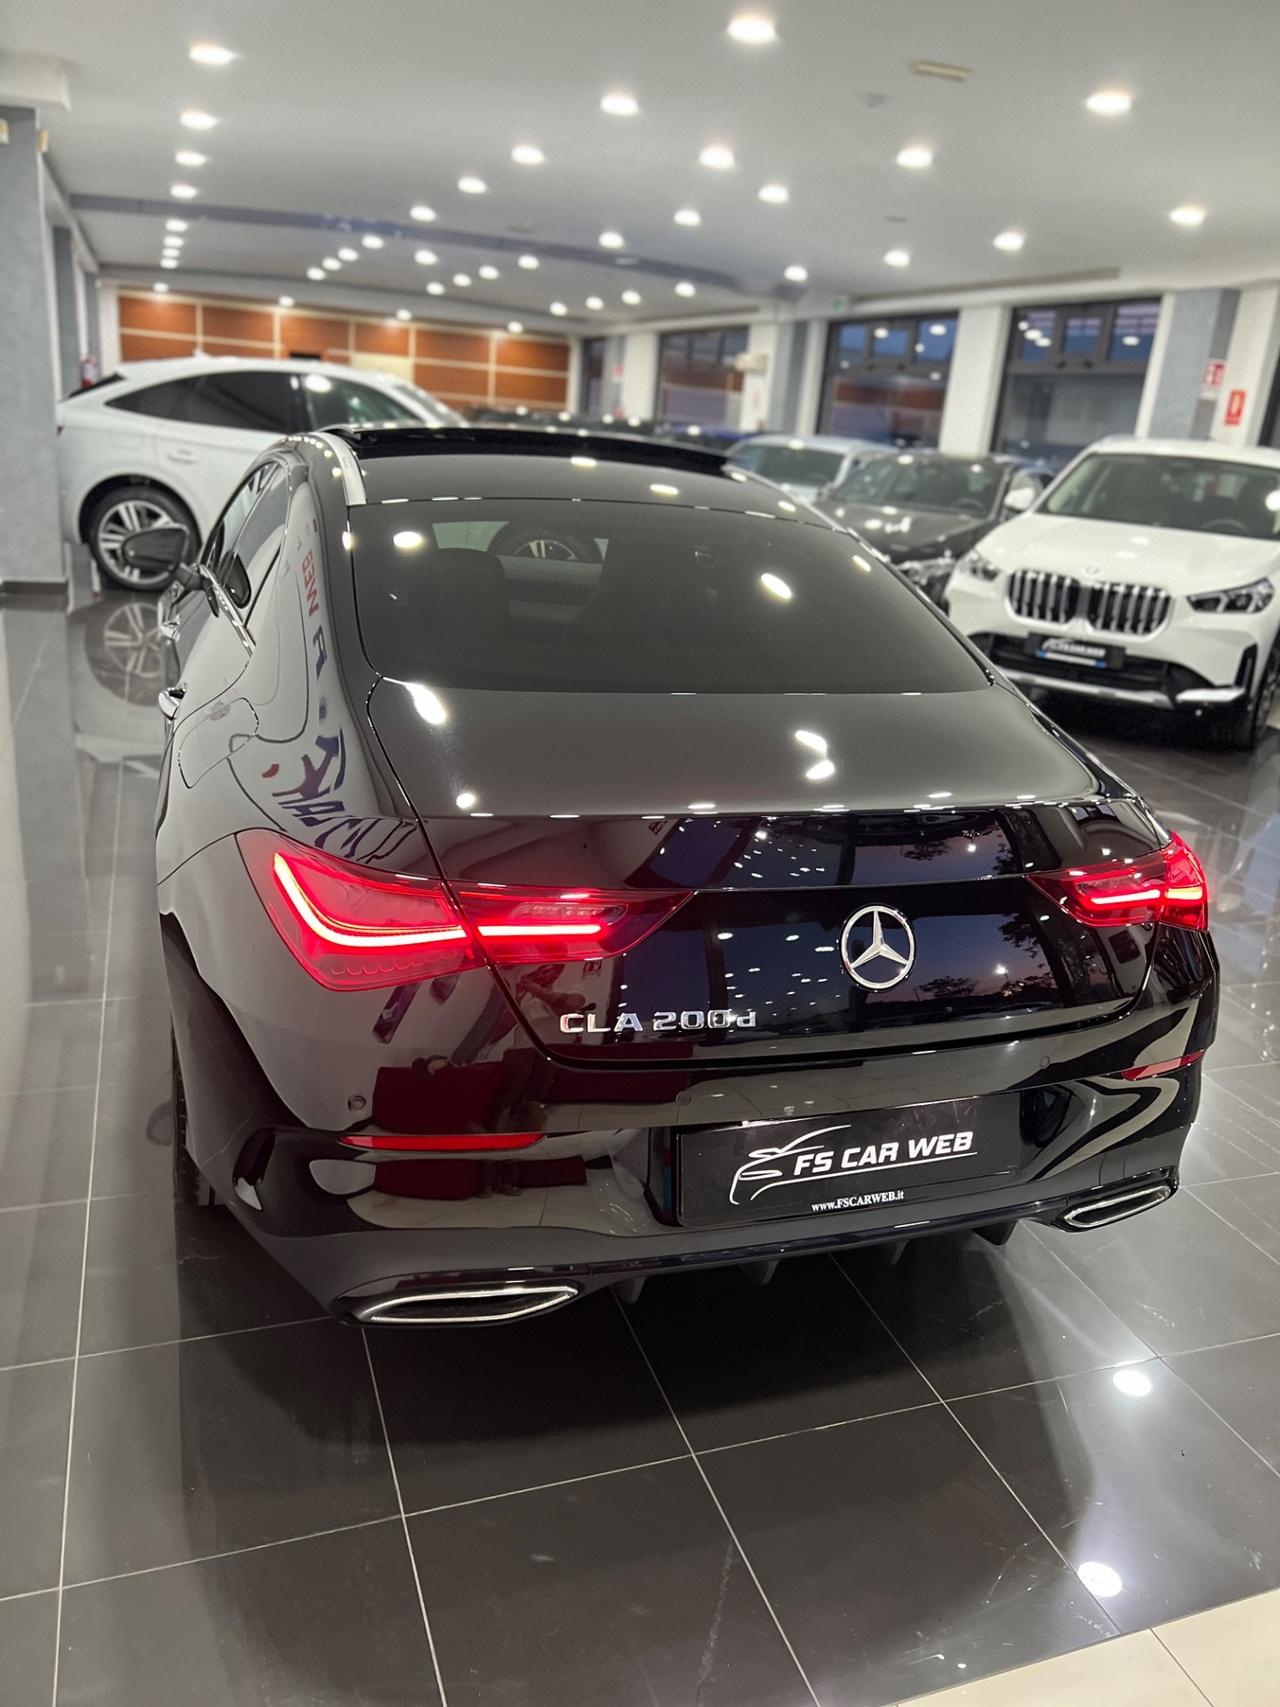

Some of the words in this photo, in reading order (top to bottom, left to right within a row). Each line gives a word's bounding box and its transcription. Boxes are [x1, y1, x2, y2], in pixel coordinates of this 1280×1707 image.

[559, 1013, 643, 1034] CLA
[793, 1149, 835, 1177] FS
[841, 1141, 900, 1168] CAR
[908, 1130, 974, 1159] WEB
[811, 1190, 905, 1212] www.FSCARWEB.it
